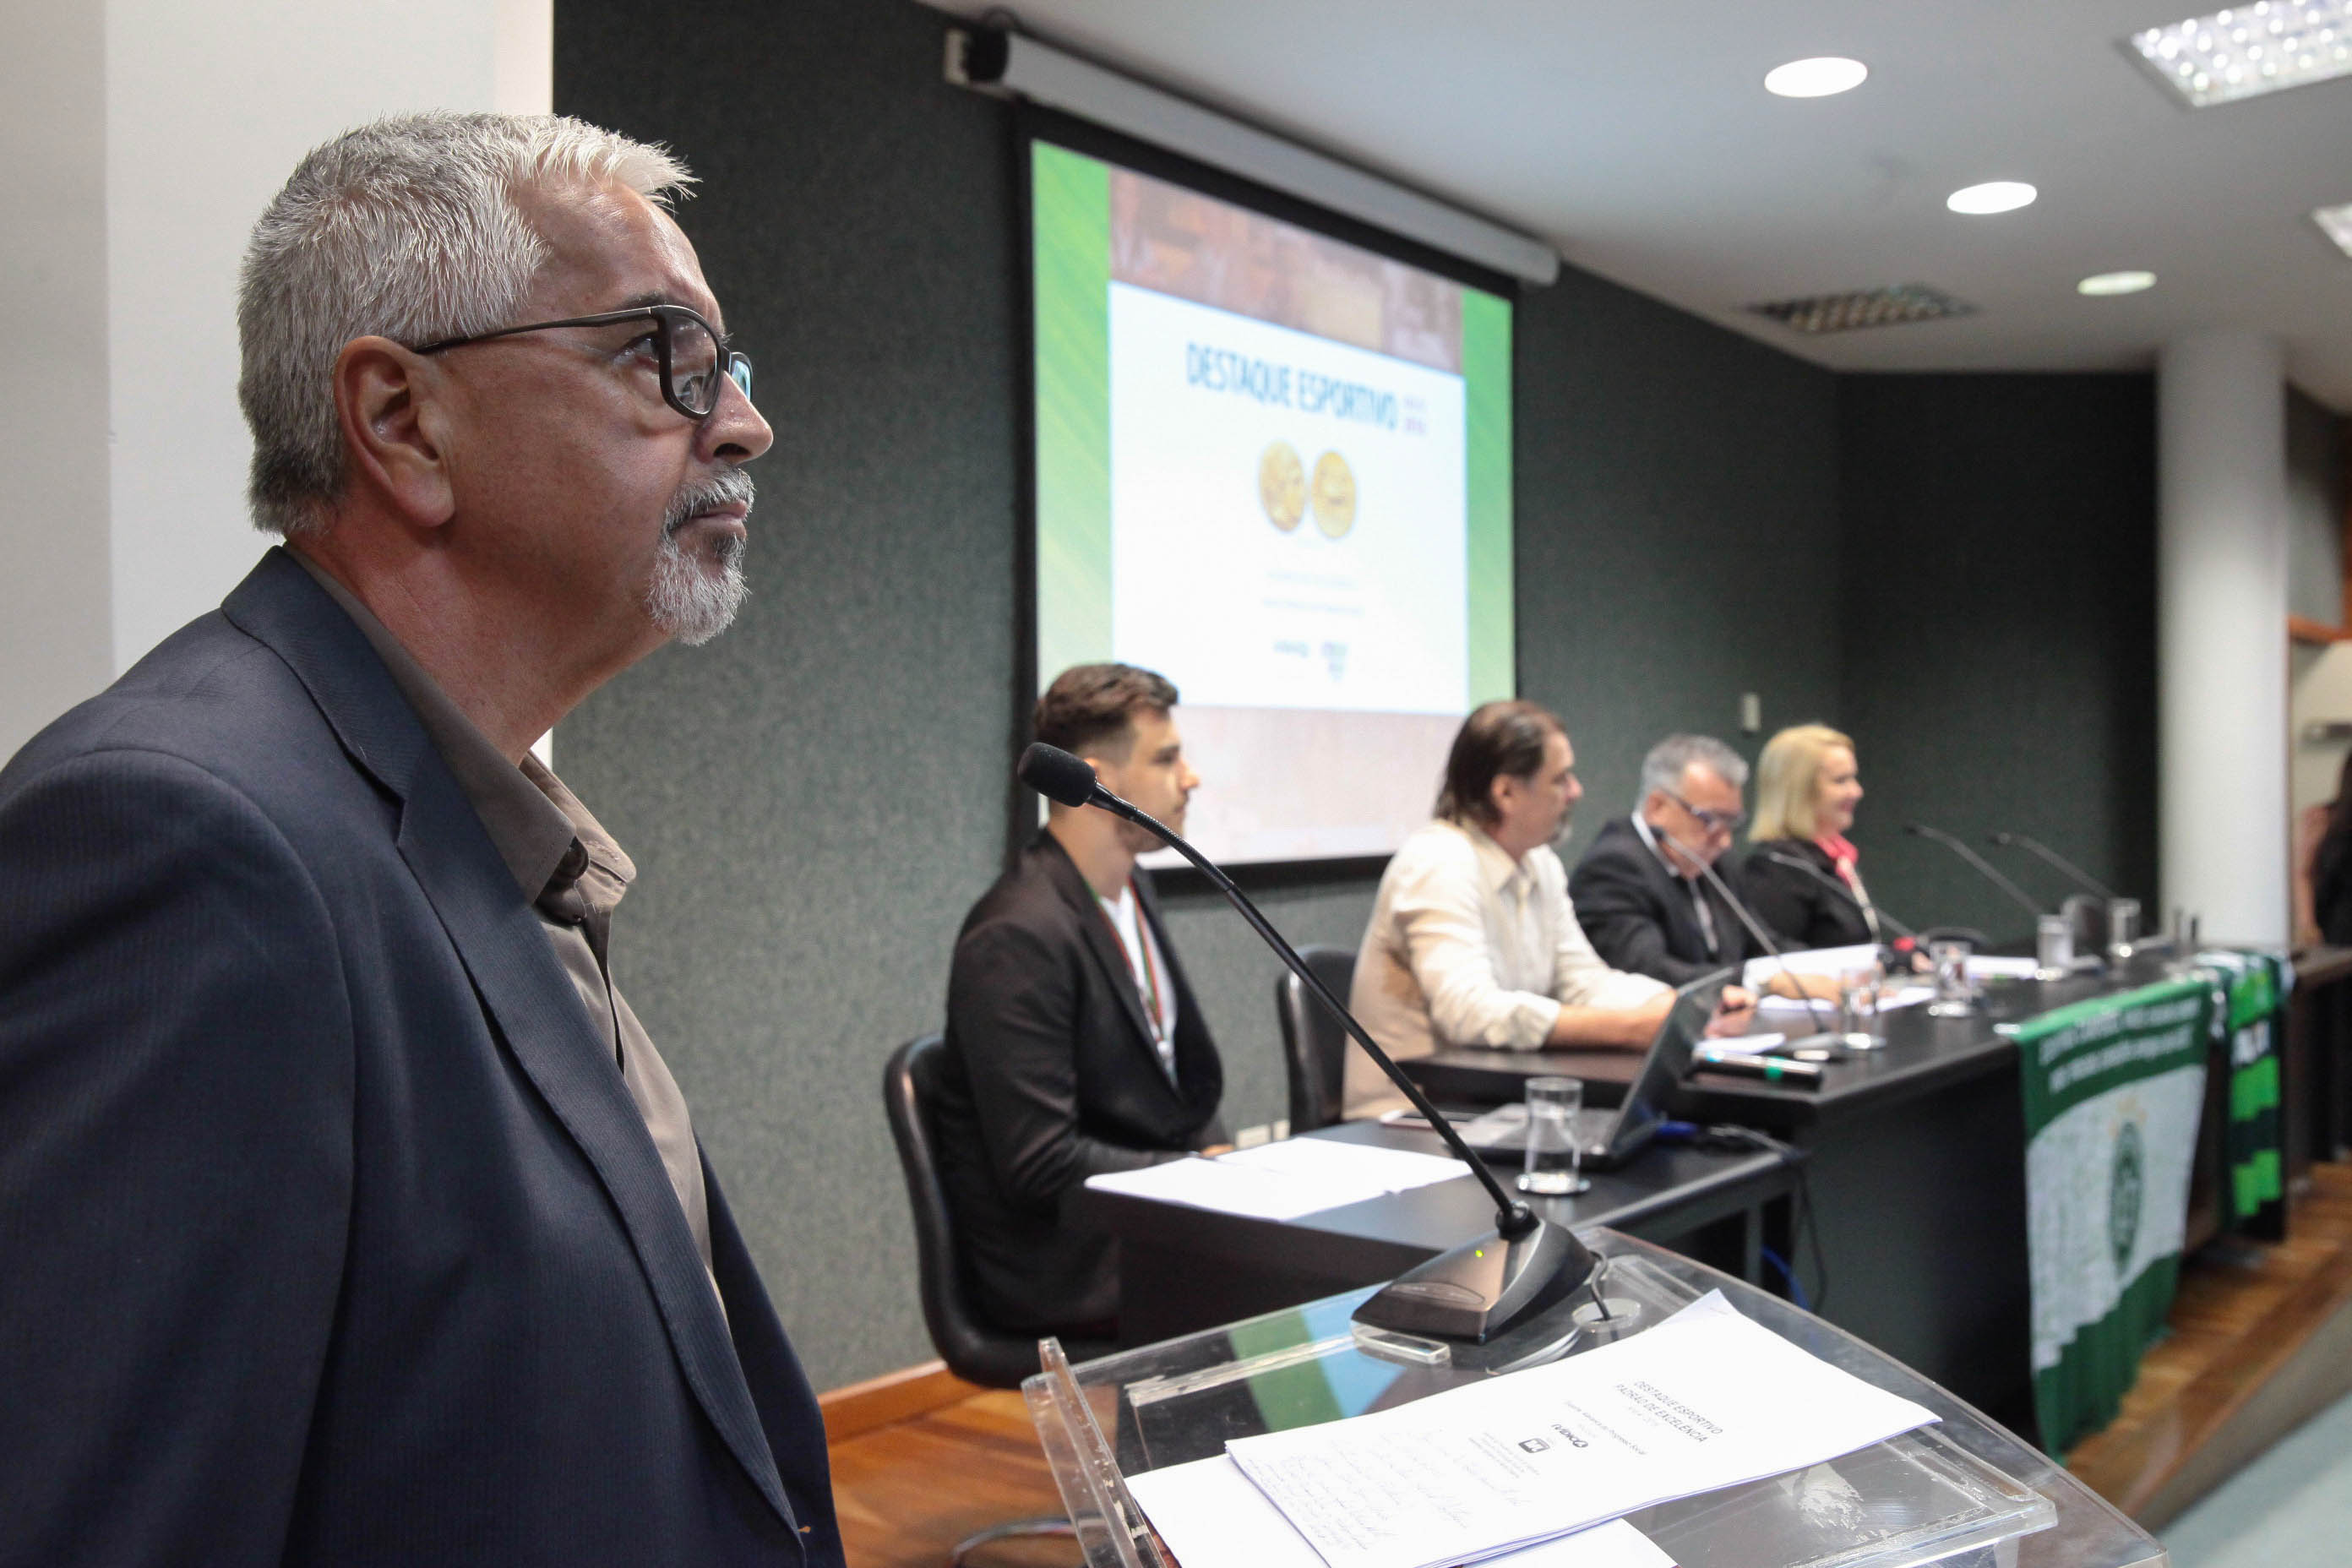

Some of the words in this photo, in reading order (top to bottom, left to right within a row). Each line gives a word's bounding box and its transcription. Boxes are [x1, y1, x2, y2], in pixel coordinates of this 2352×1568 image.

[1186, 341, 1291, 407] DESTAQUE
[1298, 369, 1398, 430] ESPORTIVO
[1634, 1380, 1679, 1407] DESTAQUE
[1674, 1405, 1723, 1435] ESPORTIVO
[1643, 1402, 1660, 1412] DE
